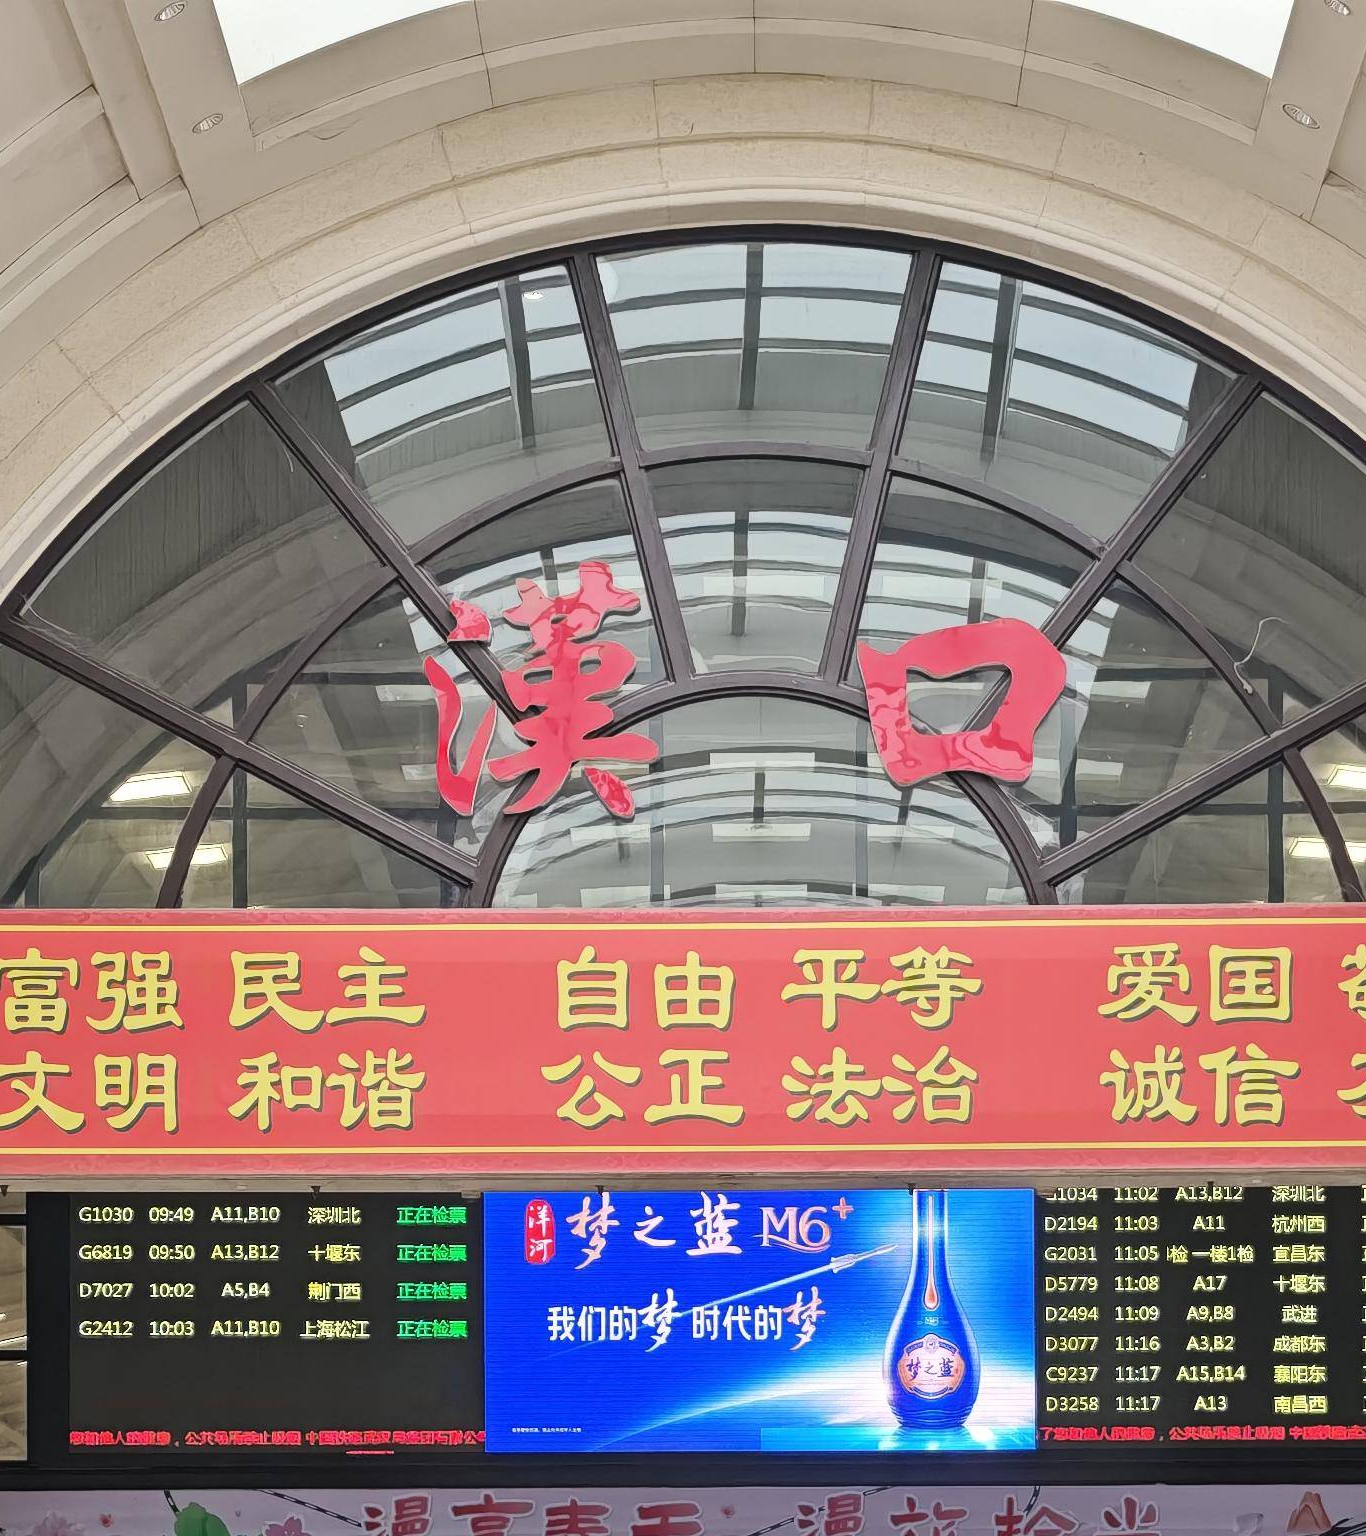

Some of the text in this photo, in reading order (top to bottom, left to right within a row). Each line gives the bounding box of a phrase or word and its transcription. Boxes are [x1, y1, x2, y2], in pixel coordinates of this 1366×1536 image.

[424, 561, 1068, 818] 漢口
[229, 947, 425, 1031] 民主
[556, 946, 735, 1029] 自由
[781, 946, 982, 1029] 平等
[1098, 943, 1292, 1024] 爱国
[228, 1049, 425, 1130] 和谐
[541, 1049, 744, 1127] 公正
[781, 1047, 977, 1125] 法治
[1099, 1043, 1299, 1125] 诚信
[1114, 1186, 1159, 1201] 11:02
[1175, 1186, 1243, 1202] A13,B12
[1271, 1185, 1327, 1203] 深圳北
[78, 1205, 468, 1226] G1030 09:49 A11,B10 深圳北 正在检票
[1043, 1215, 1099, 1233] D2194
[1114, 1215, 1160, 1233] 11:03
[1192, 1214, 1226, 1232] A11
[1271, 1213, 1327, 1235] 杭州西
[528, 1204, 552, 1262] 洋河
[566, 1191, 743, 1270] 梦之蓝
[78, 1243, 468, 1264] G6819 09:50 A13,B12 十堰东 正在检票
[1044, 1245, 1098, 1264] G2031
[1114, 1245, 1161, 1263] 11:05
[1191, 1244, 1255, 1264] 一楼1检
[1272, 1243, 1326, 1264] 宜昌东
[79, 1281, 468, 1303] D7027 10:02 A5,B4 荆门西 正在检票
[1044, 1276, 1099, 1293] D5779
[1114, 1275, 1161, 1293] 11:08
[1192, 1274, 1228, 1293] A17
[1272, 1273, 1326, 1294] 十堰东
[547, 1286, 826, 1352] 我们的梦 时代的梦
[1045, 1306, 1100, 1323] D2494
[1114, 1305, 1161, 1322] 11:09
[1185, 1305, 1236, 1323] A9,B8
[1281, 1304, 1318, 1325] 武进
[78, 1318, 468, 1341] G2412 10:03 A11,B10 上海松江 正在检票
[1045, 1336, 1100, 1353] D3077
[1115, 1335, 1162, 1353] 11:16
[1185, 1335, 1236, 1353] A3,B2
[1272, 1334, 1327, 1354] 成都东
[906, 1357, 955, 1380] 梦之蓝
[1045, 1366, 1100, 1384] C9237
[1115, 1365, 1162, 1384] 11:17
[1175, 1364, 1247, 1383] A15,B14
[1273, 1364, 1328, 1385] 襄阳东
[1045, 1396, 1100, 1413] D3258
[1115, 1395, 1161, 1413] 11:17
[1193, 1395, 1229, 1413] A13
[1273, 1394, 1329, 1415] 南昌西
